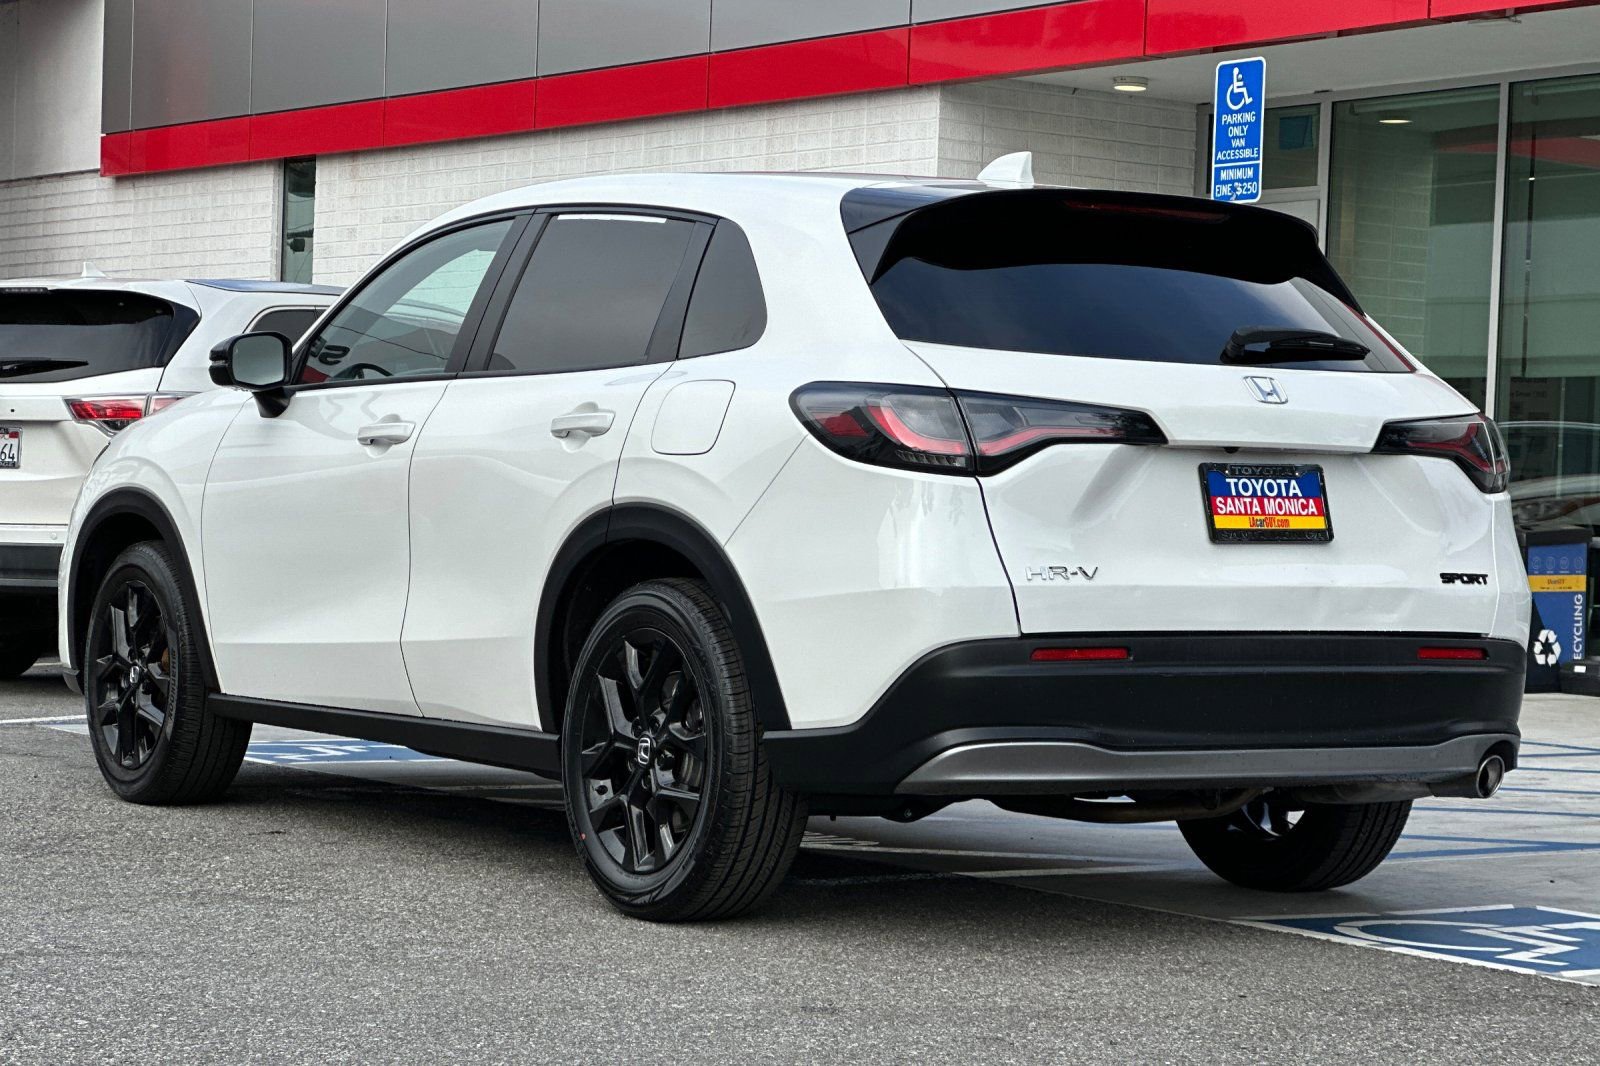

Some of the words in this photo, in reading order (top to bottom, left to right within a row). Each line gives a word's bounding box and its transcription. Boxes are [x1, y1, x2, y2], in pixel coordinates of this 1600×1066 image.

[1222, 112, 1256, 125] PARKING
[1228, 125, 1249, 137] ONLY
[1231, 138, 1245, 147] VAN
[1216, 148, 1259, 161] ACCESSIBLE
[1220, 167, 1254, 181] MINIMUM
[1235, 182, 1257, 196] $250
[1225, 478, 1303, 497] TOYOTA
[1216, 497, 1262, 515] SANTA
[1263, 498, 1319, 516] MONICA
[1025, 566, 1099, 581] HR-V
[1439, 572, 1489, 585] SPORT
[1573, 593, 1584, 660] ECYCLING
